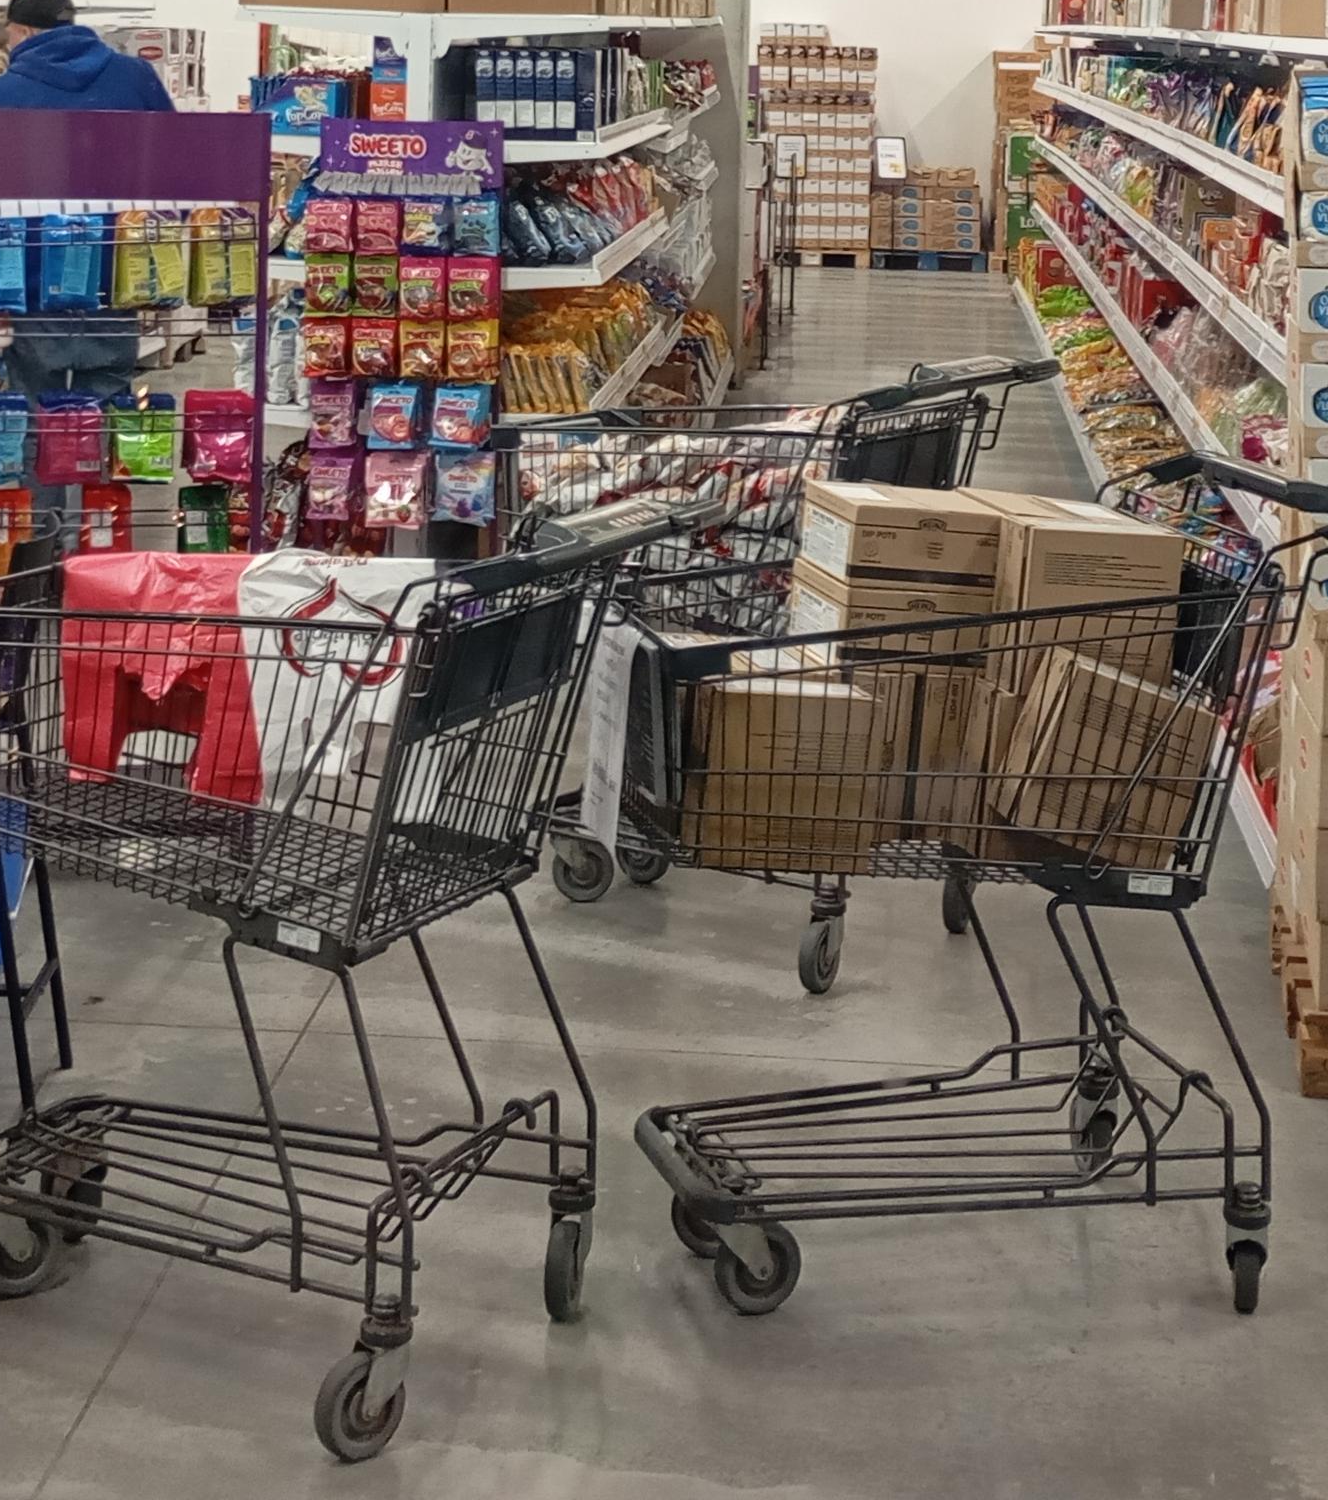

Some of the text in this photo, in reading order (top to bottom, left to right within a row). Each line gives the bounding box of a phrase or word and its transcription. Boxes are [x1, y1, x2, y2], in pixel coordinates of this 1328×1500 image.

[285, 106, 324, 123] PopCor
[350, 134, 426, 157] SWEETO
[876, 531, 897, 540] POTS
